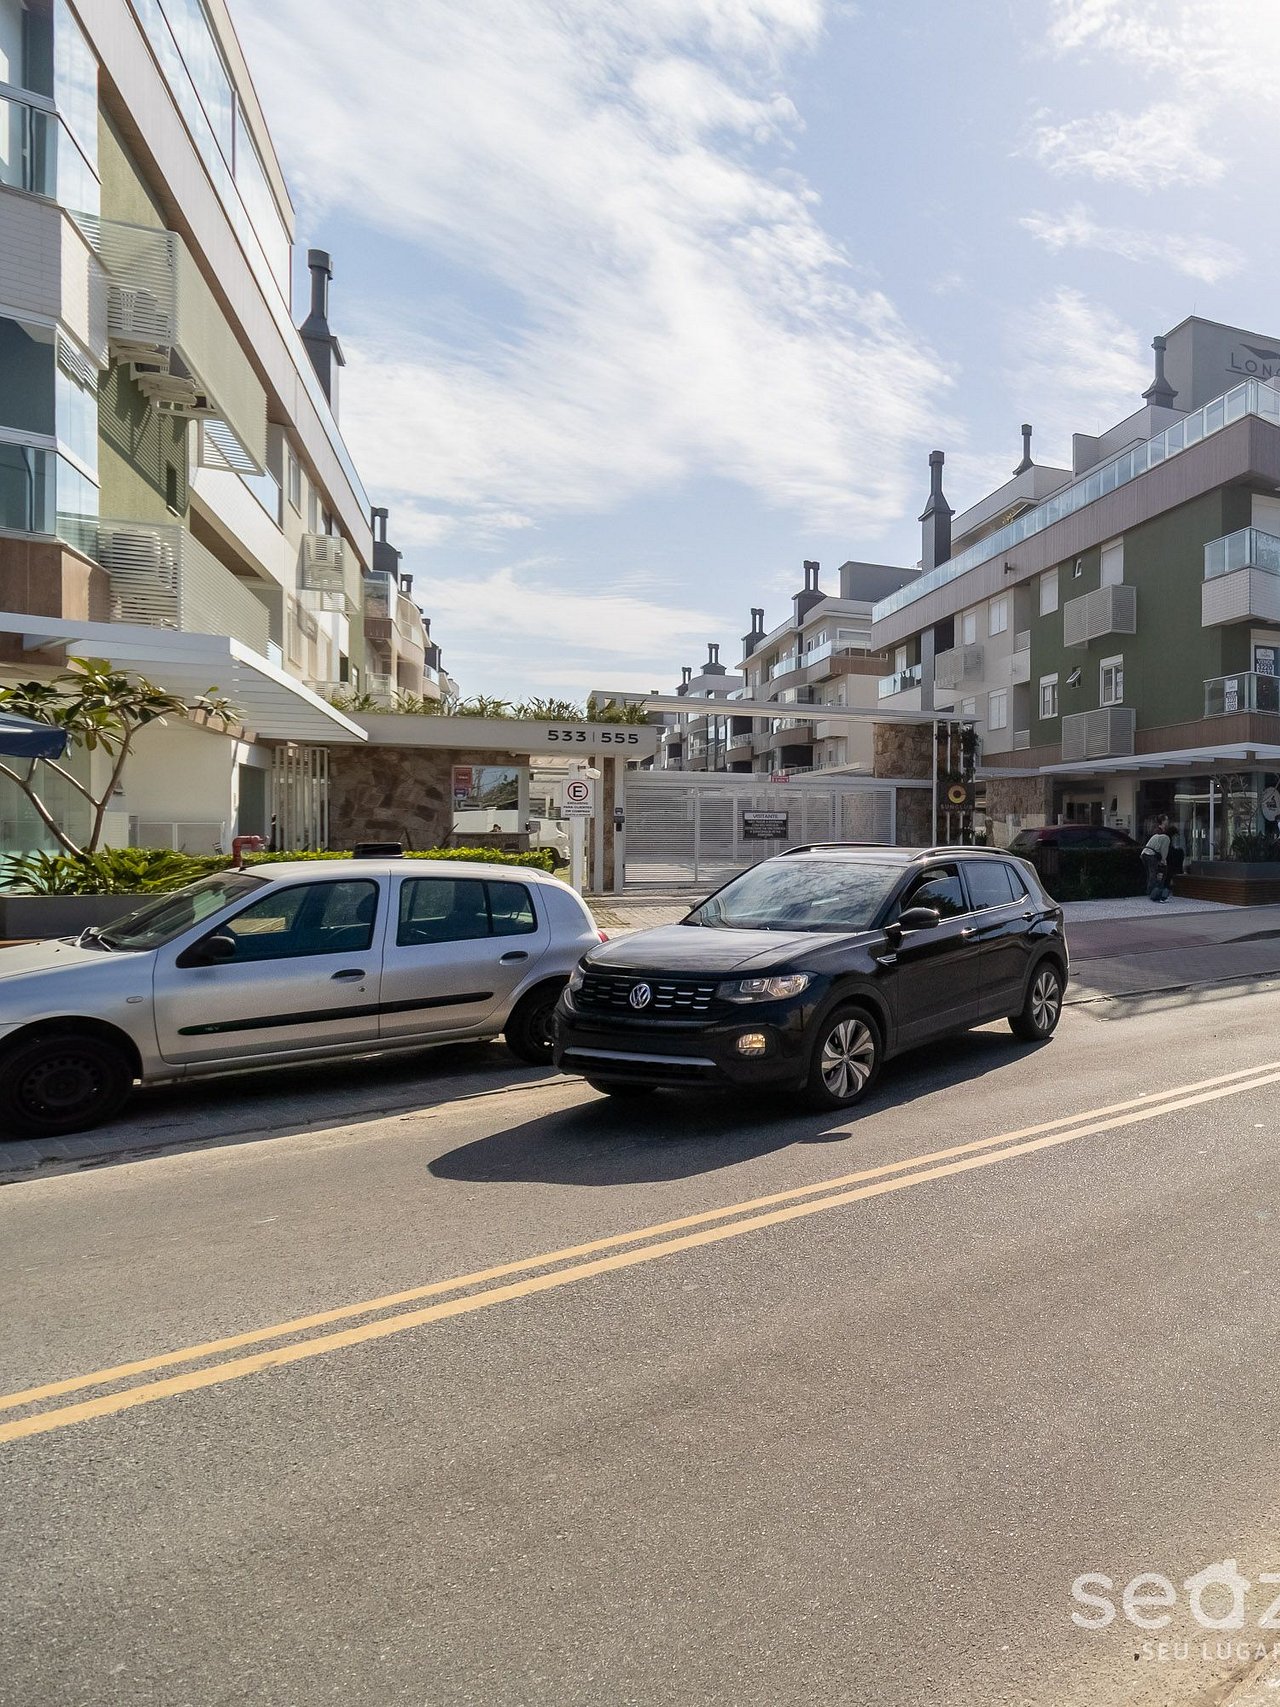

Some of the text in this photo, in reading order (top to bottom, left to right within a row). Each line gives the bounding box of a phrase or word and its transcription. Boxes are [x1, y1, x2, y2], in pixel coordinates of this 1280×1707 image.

[547, 729, 639, 744] 533 555
[572, 785, 583, 798] E
